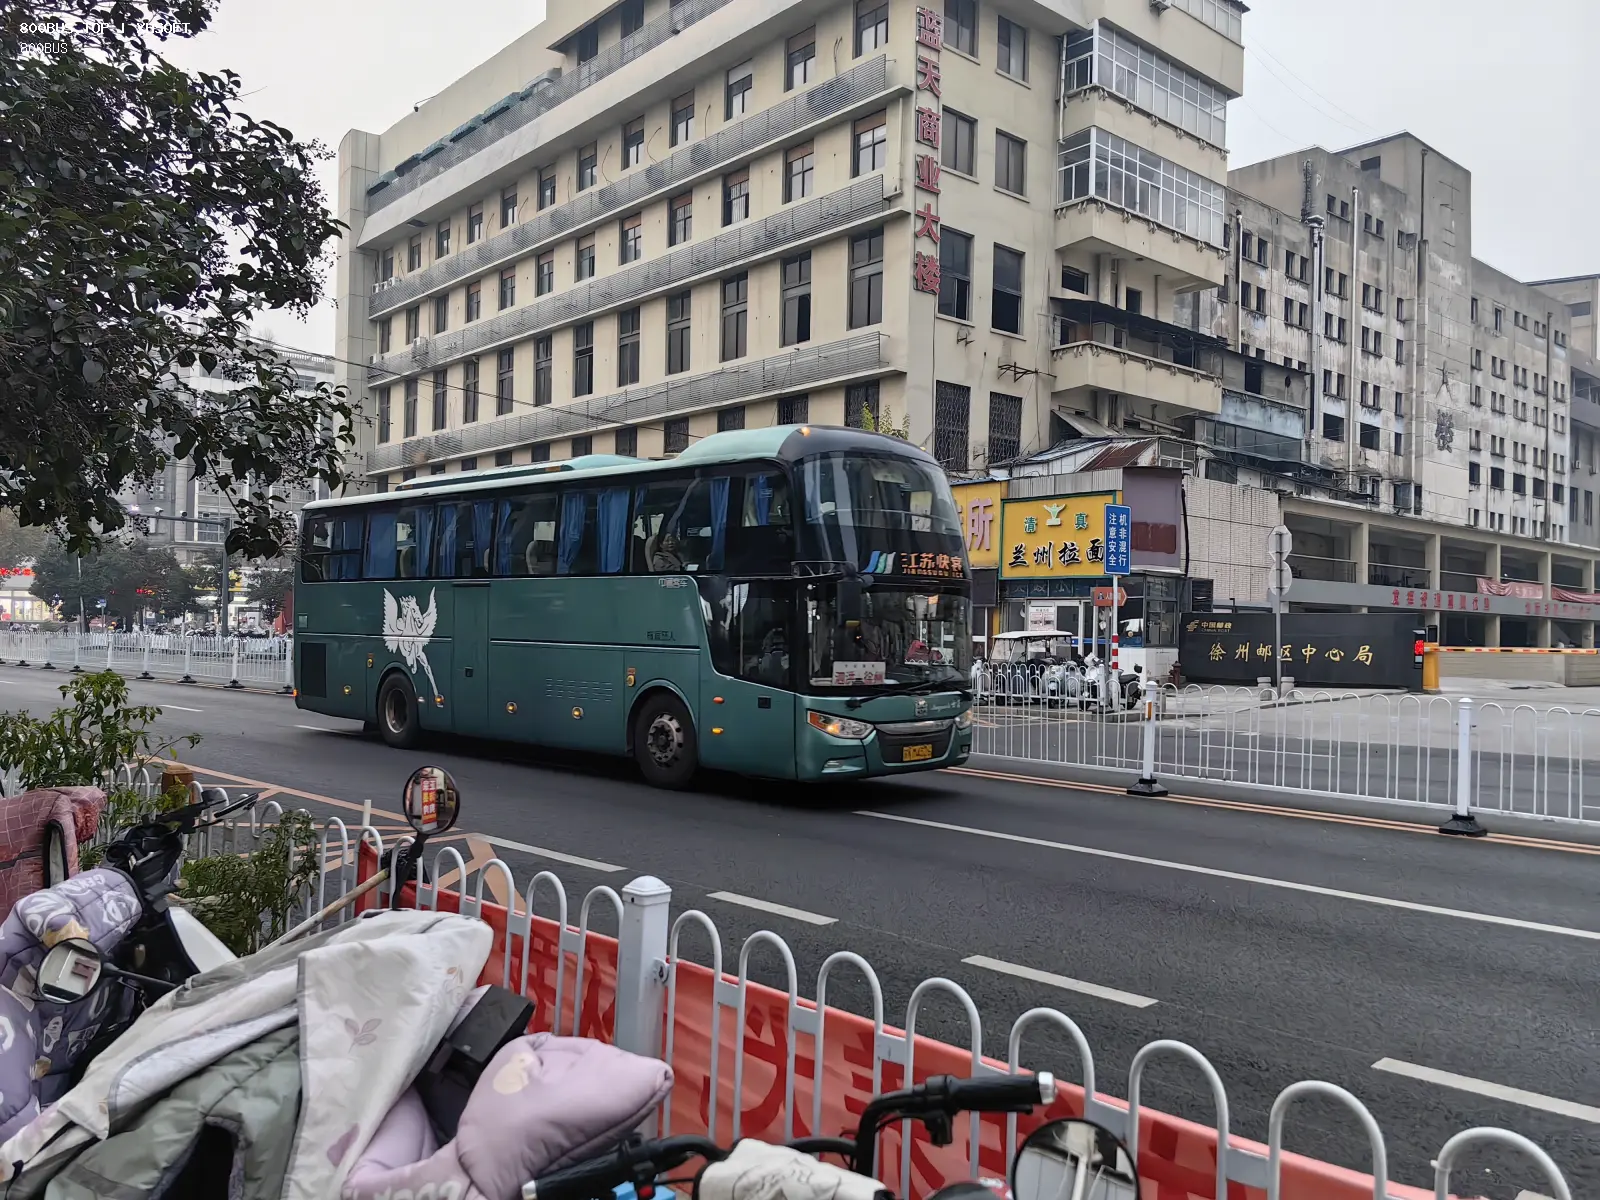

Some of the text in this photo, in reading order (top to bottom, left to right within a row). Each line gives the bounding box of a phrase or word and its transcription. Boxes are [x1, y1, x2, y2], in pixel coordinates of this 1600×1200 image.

[914, 6, 942, 294] 蓝天商业大楼
[957, 497, 994, 551] 所
[1108, 512, 1118, 567] 注意安全
[1118, 513, 1128, 567] 机非混行
[1008, 538, 1105, 569] 兰州拉面
[1207, 641, 1374, 667] 徐州邮区中心局
